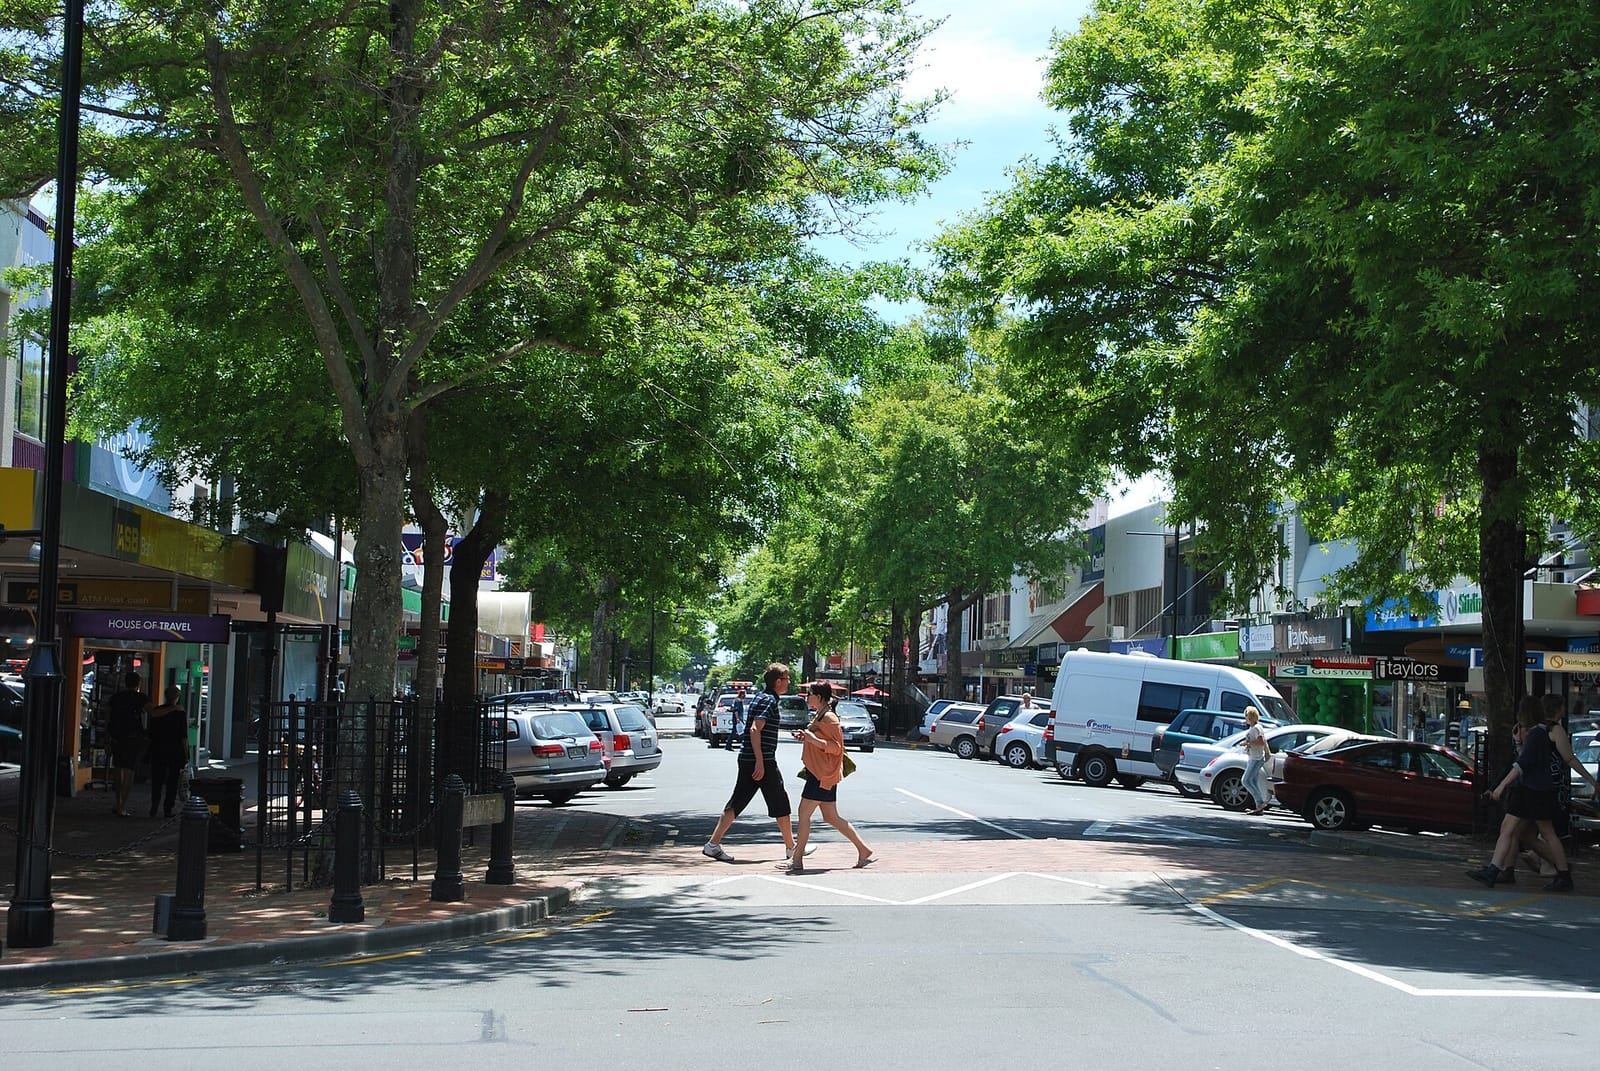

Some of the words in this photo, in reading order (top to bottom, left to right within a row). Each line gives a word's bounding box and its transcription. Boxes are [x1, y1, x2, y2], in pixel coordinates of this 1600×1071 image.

[117, 522, 139, 552] ASB
[26, 588, 74, 602] AB
[108, 620, 141, 630] HOUSE
[143, 621, 158, 630] OF
[160, 622, 191, 632] TRAVEL
[1387, 660, 1439, 678] taylors
